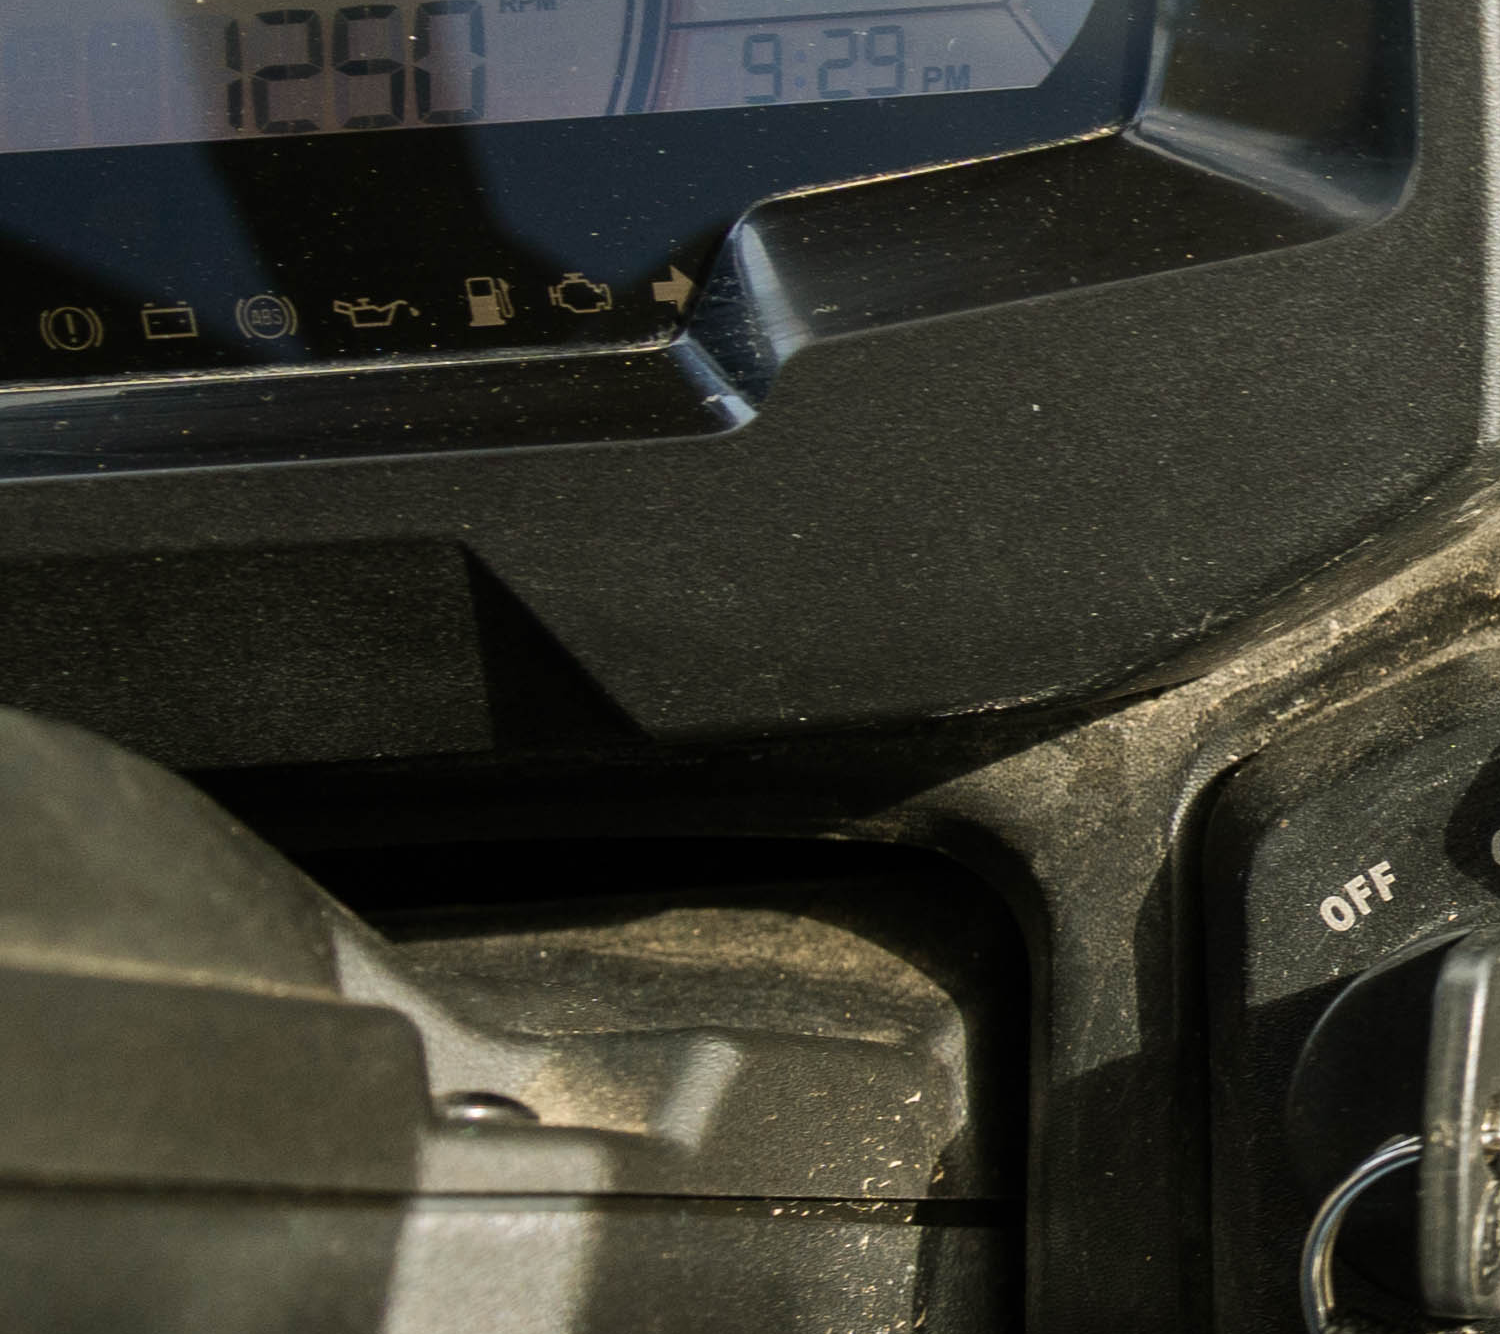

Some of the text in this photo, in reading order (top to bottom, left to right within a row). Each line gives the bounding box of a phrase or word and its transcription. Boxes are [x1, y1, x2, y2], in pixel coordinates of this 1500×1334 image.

[743, 24, 972, 104] 9:29 PM
[249, 308, 283, 326] ABS
[1318, 860, 1397, 933] OFF
